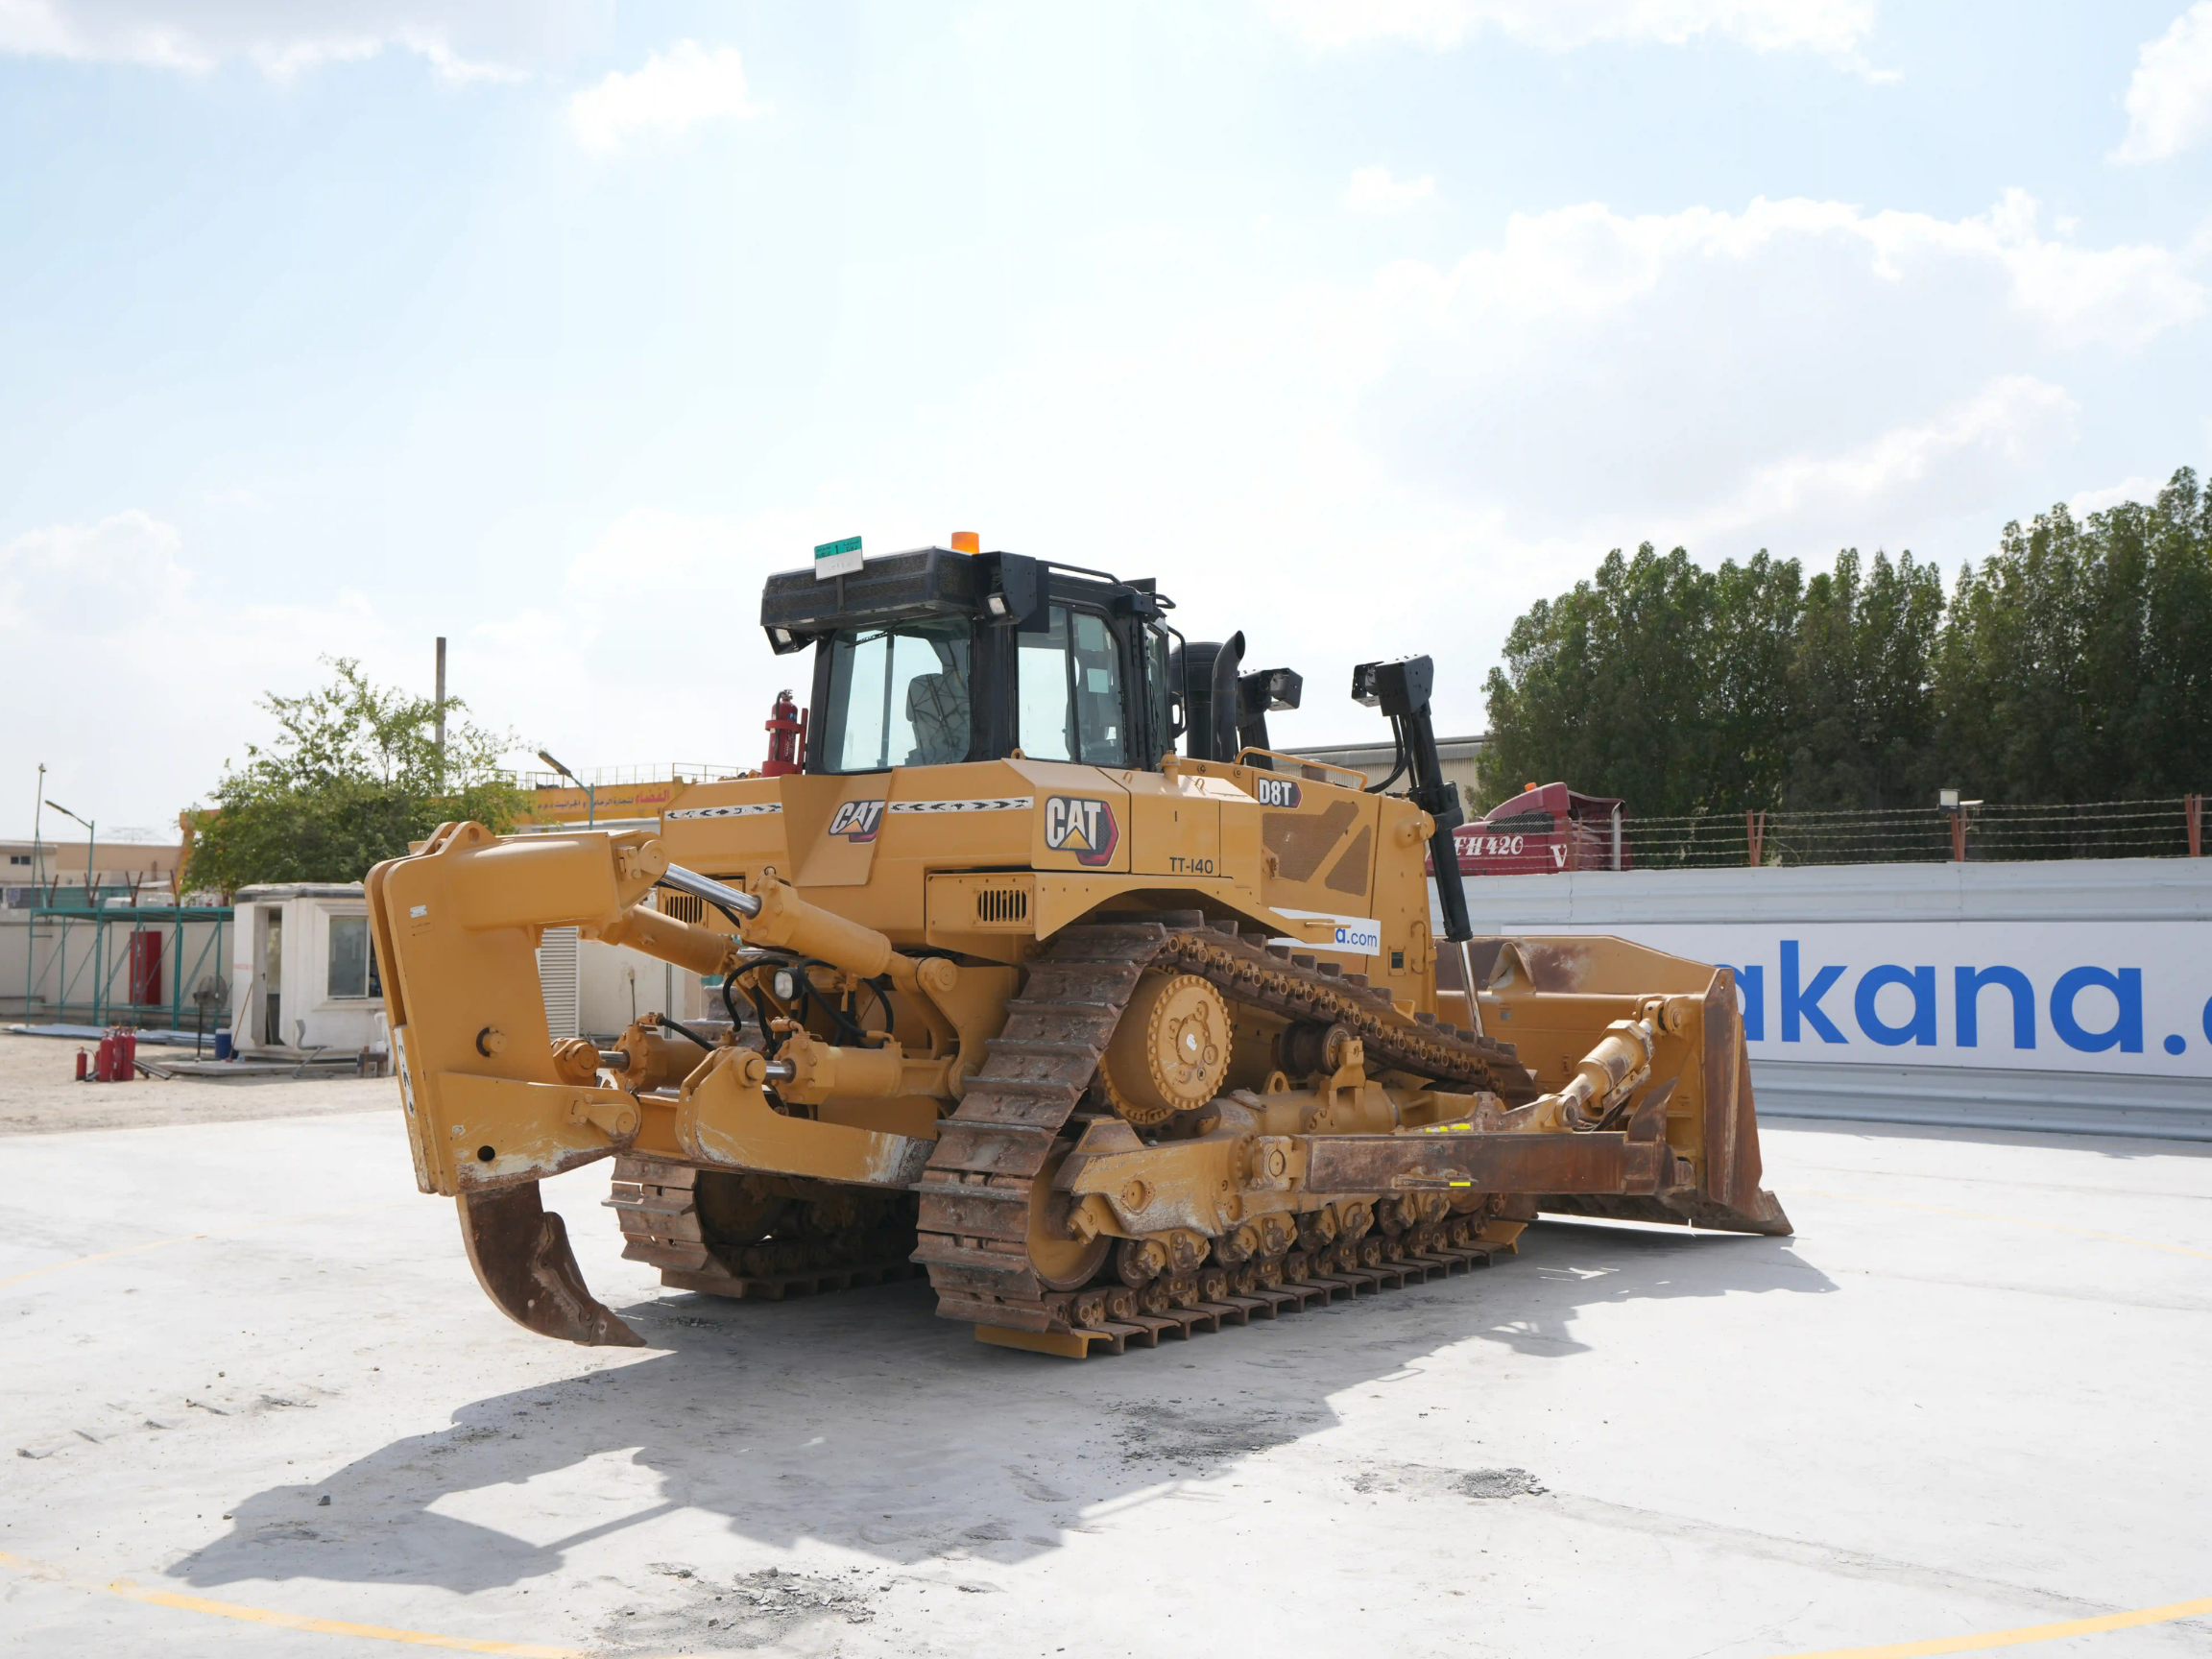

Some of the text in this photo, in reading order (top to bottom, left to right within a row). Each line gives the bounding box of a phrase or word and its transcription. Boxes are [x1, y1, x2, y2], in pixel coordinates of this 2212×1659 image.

[1260, 779, 1291, 806] D8T
[830, 800, 885, 833] CAT
[1046, 797, 1102, 851] CAT
[1486, 835, 1524, 855] 420
